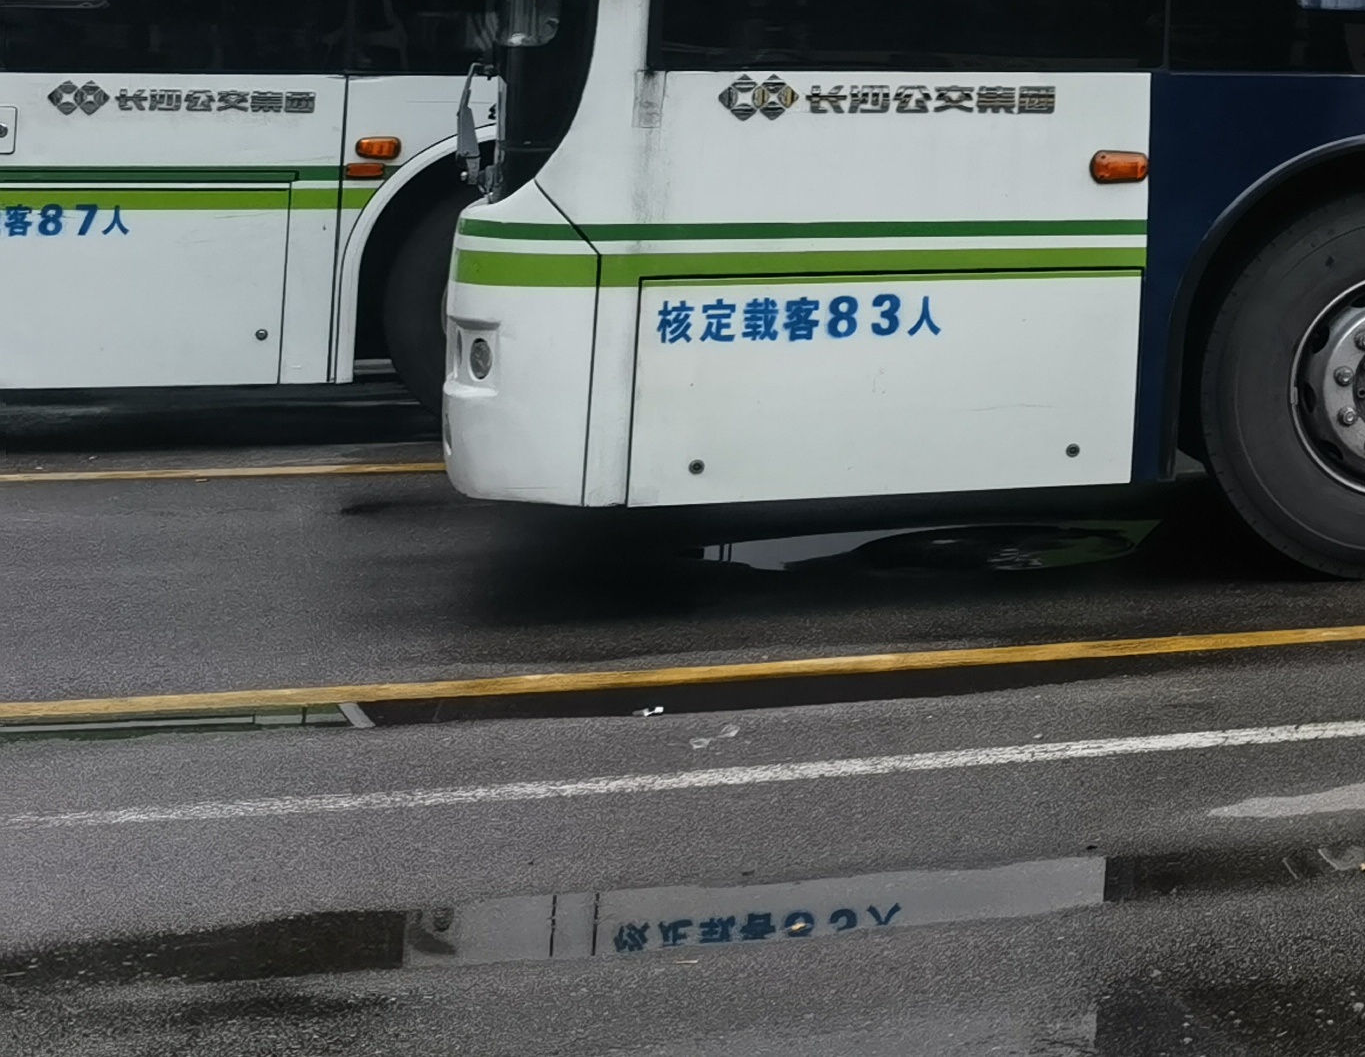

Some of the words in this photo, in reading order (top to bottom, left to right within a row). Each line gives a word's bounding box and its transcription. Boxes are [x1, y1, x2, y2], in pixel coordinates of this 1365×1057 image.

[805, 84, 1056, 115] 长沙公交集团
[0, 204, 130, 237] 客87人
[657, 293, 941, 344] 核定载客83人
